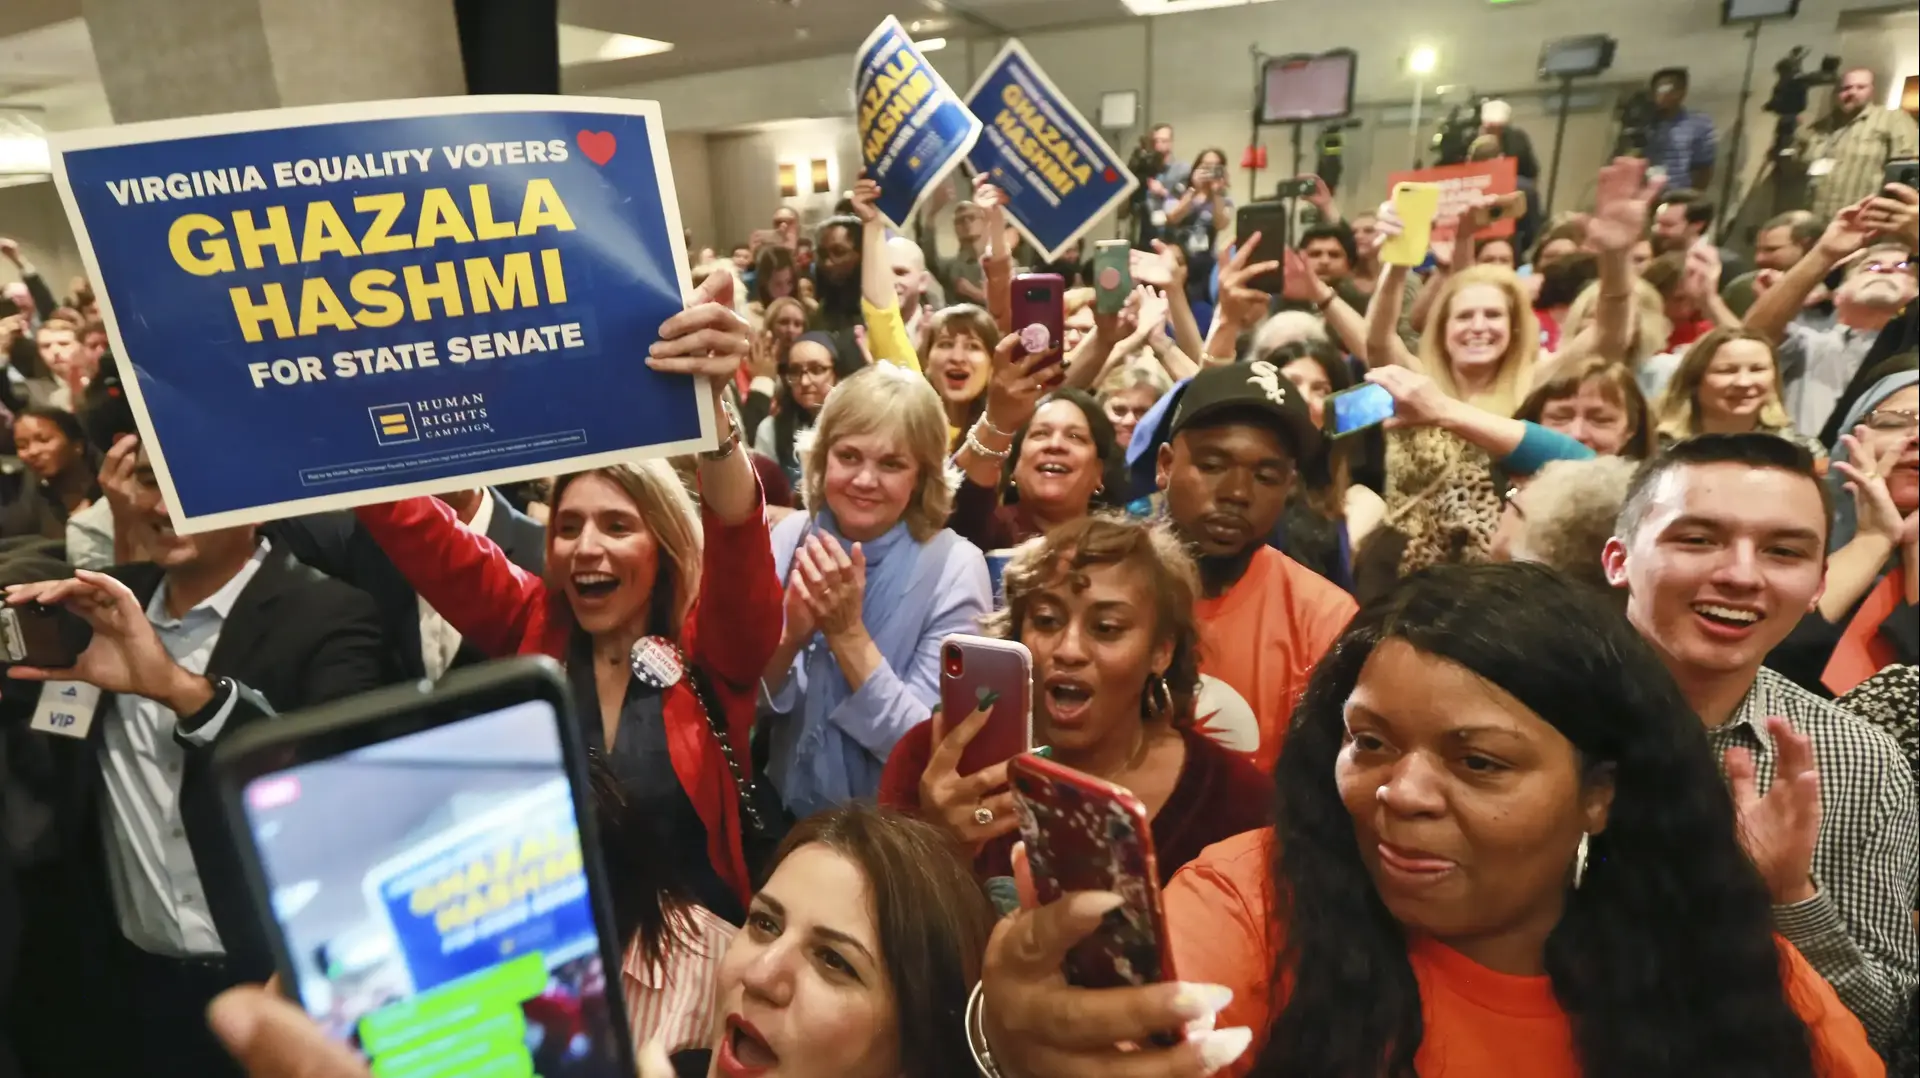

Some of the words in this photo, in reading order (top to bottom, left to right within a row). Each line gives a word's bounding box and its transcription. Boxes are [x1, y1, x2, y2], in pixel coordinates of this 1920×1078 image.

[106, 166, 267, 205] VIRGINIA
[274, 148, 434, 186] EQUALITY
[444, 138, 569, 170] VOTERS
[167, 178, 577, 276] GHAZALA
[229, 248, 568, 343] HASHMI
[248, 357, 327, 388] FOR
[333, 341, 440, 378] STATE
[447, 322, 585, 362] SENATE
[417, 392, 485, 412] HUMAN
[421, 407, 489, 427] RIGHTS
[50, 711, 75, 728] VIP
